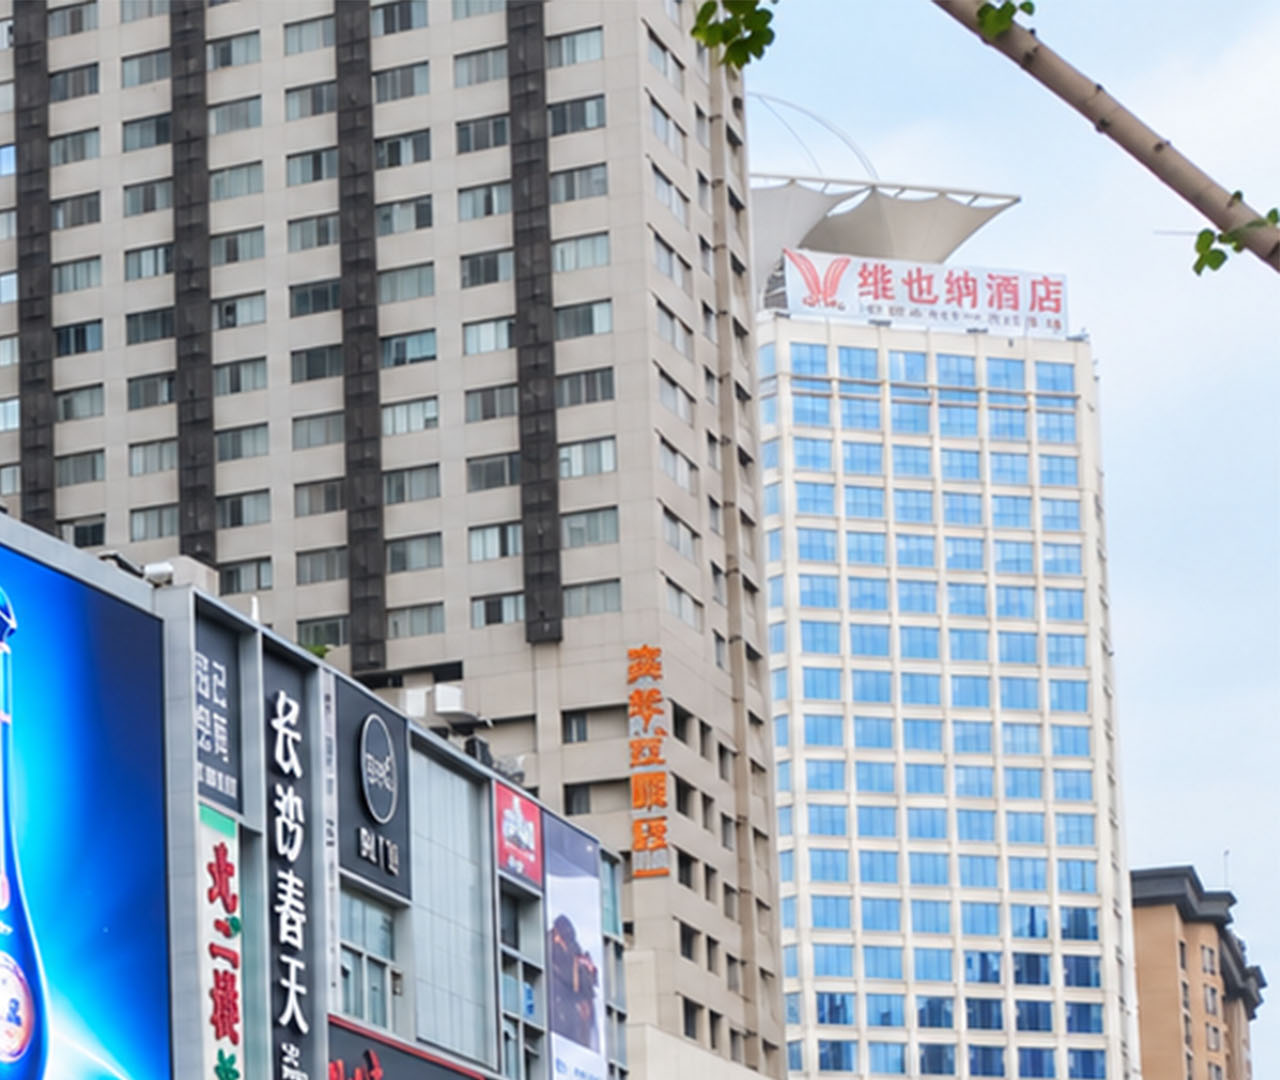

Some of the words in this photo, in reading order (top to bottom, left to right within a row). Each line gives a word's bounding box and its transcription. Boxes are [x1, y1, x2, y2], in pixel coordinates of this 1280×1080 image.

[857, 263, 1063, 313] 维也纳酒店
